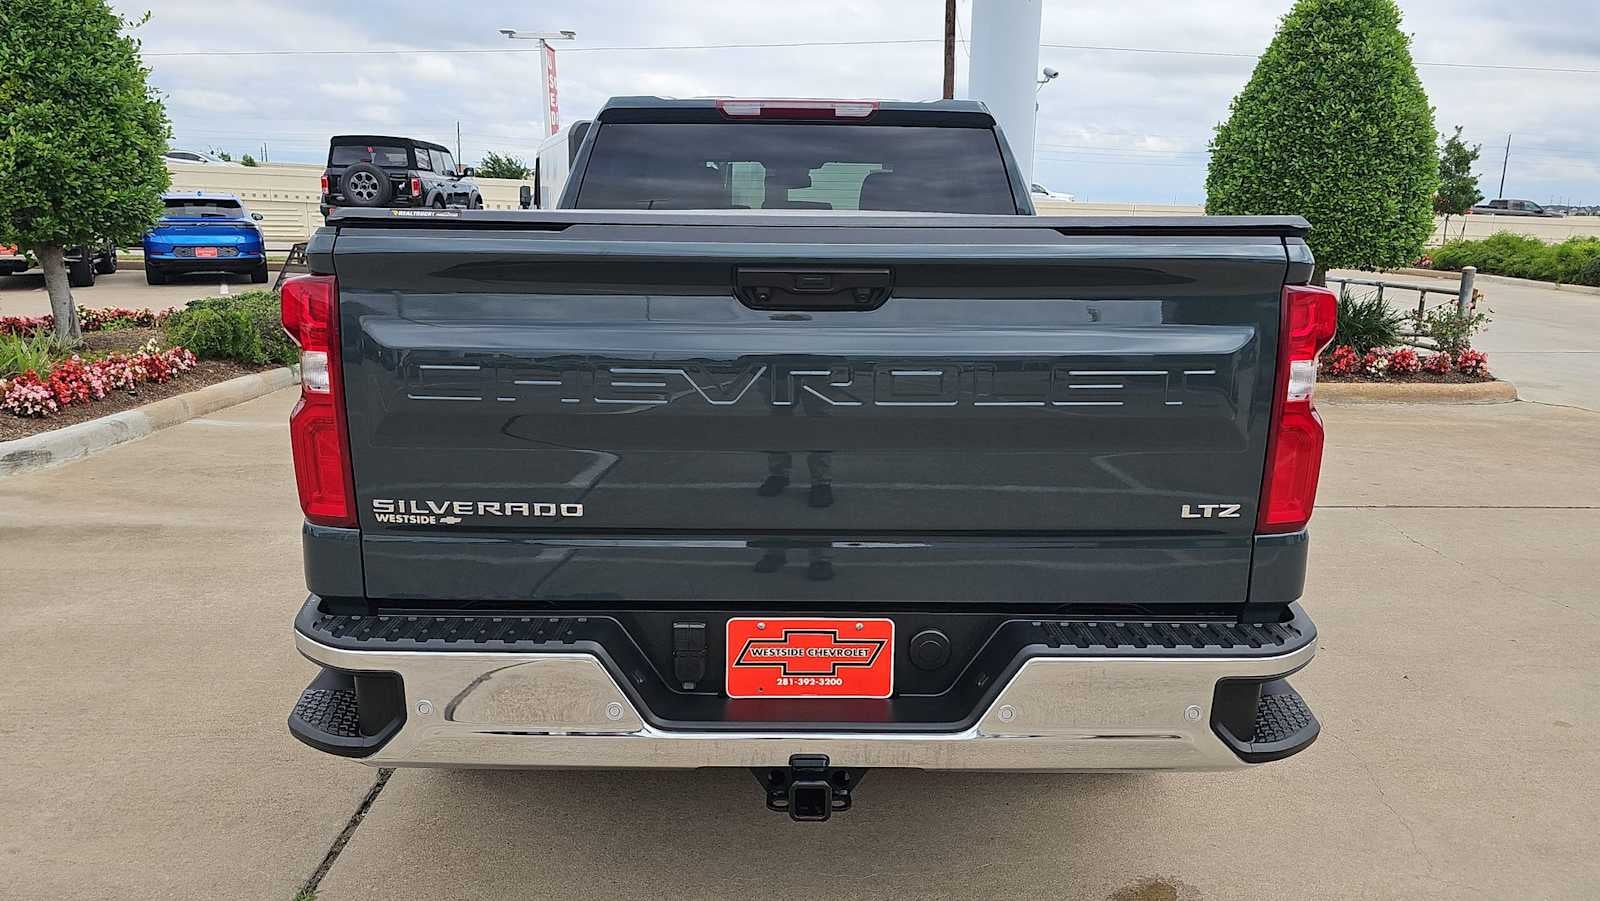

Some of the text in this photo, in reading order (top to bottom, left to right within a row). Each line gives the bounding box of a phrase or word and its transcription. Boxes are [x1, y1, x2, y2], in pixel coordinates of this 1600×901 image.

[547, 54, 559, 127] USED
[406, 363, 1217, 407] CHEVROLET
[372, 498, 584, 517] SILVERADO
[1181, 503, 1241, 519] LTZ
[374, 513, 437, 525] WESTSIDE
[750, 647, 870, 658] WESTSIDE CHEVROLET
[776, 677, 843, 687] 281-392-3200
